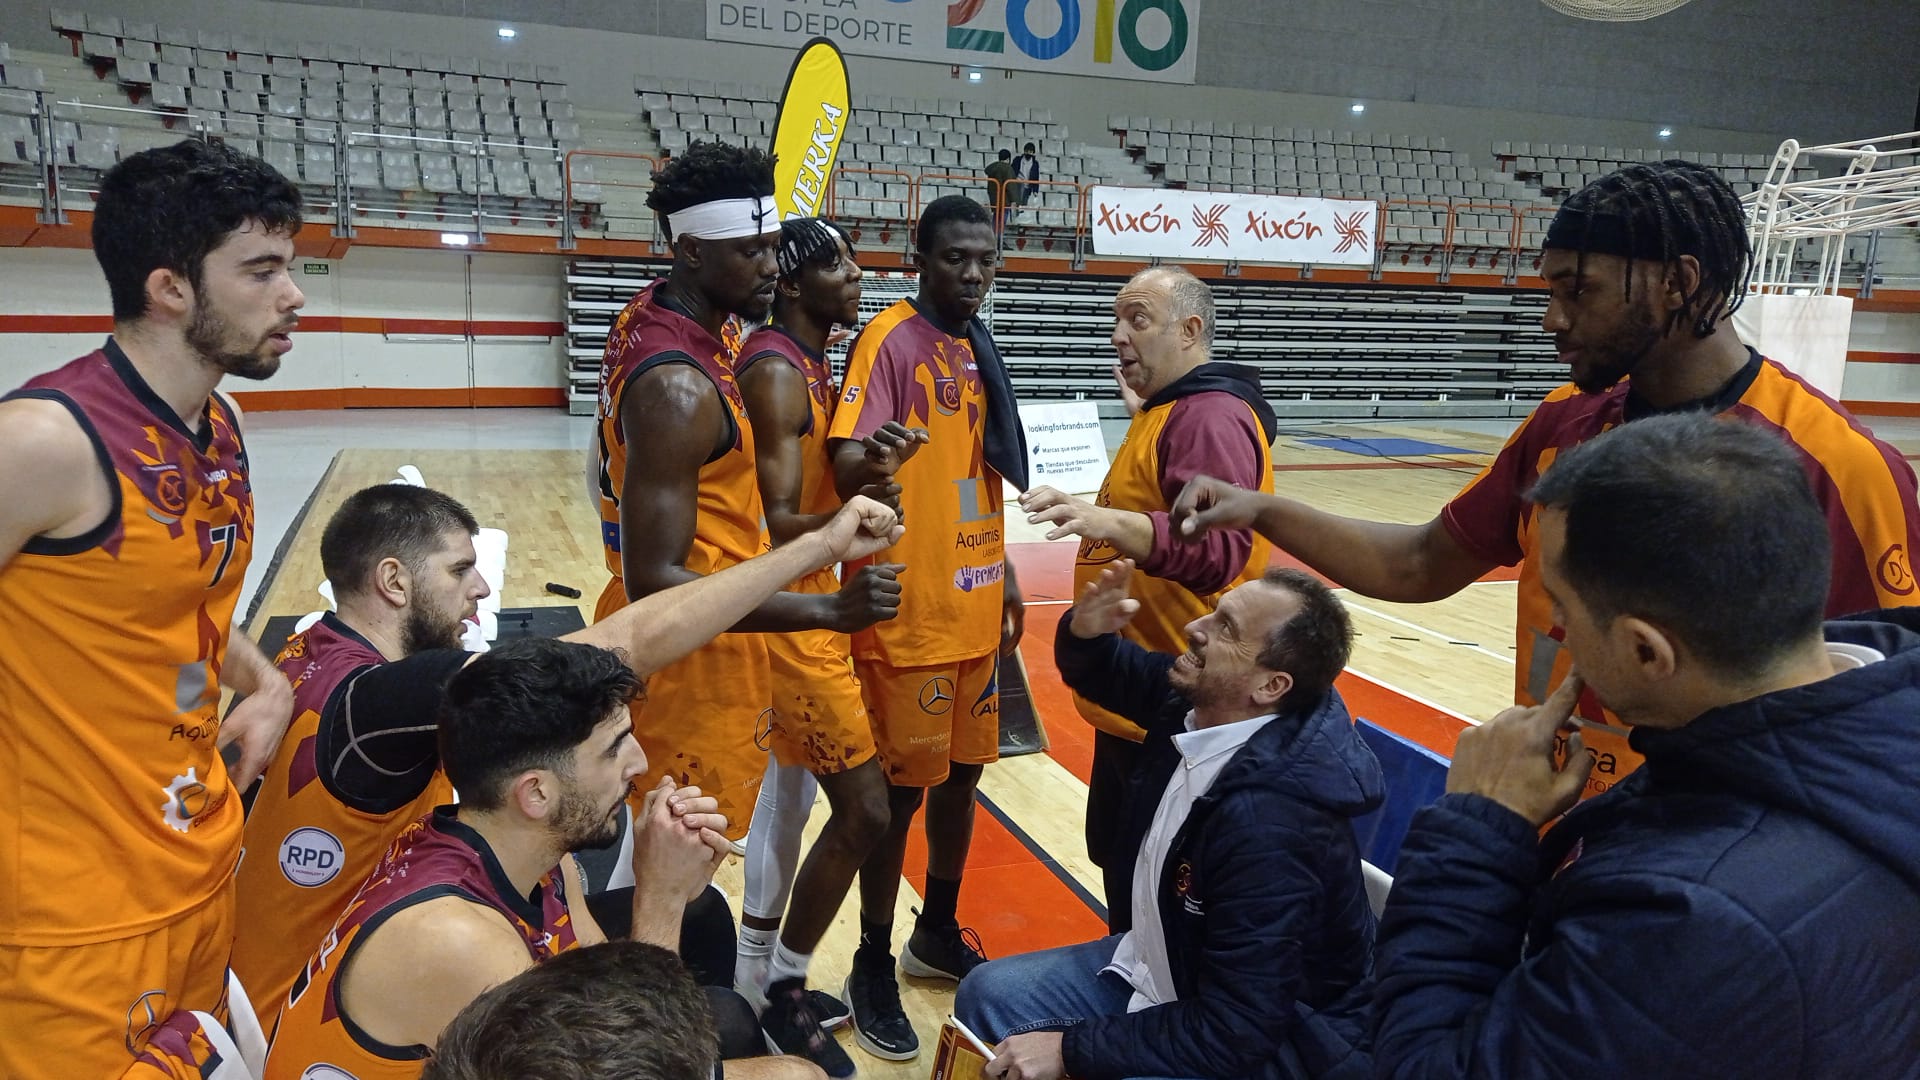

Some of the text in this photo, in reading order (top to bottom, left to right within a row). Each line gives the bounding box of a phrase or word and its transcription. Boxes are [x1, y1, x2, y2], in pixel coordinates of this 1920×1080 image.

[720, 3, 913, 46] DEL DEPORTE
[843, 385, 861, 404] 5
[1028, 421, 1099, 433] lookingforbrands.com
[205, 524, 237, 590] 7
[287, 845, 334, 868] RPD
